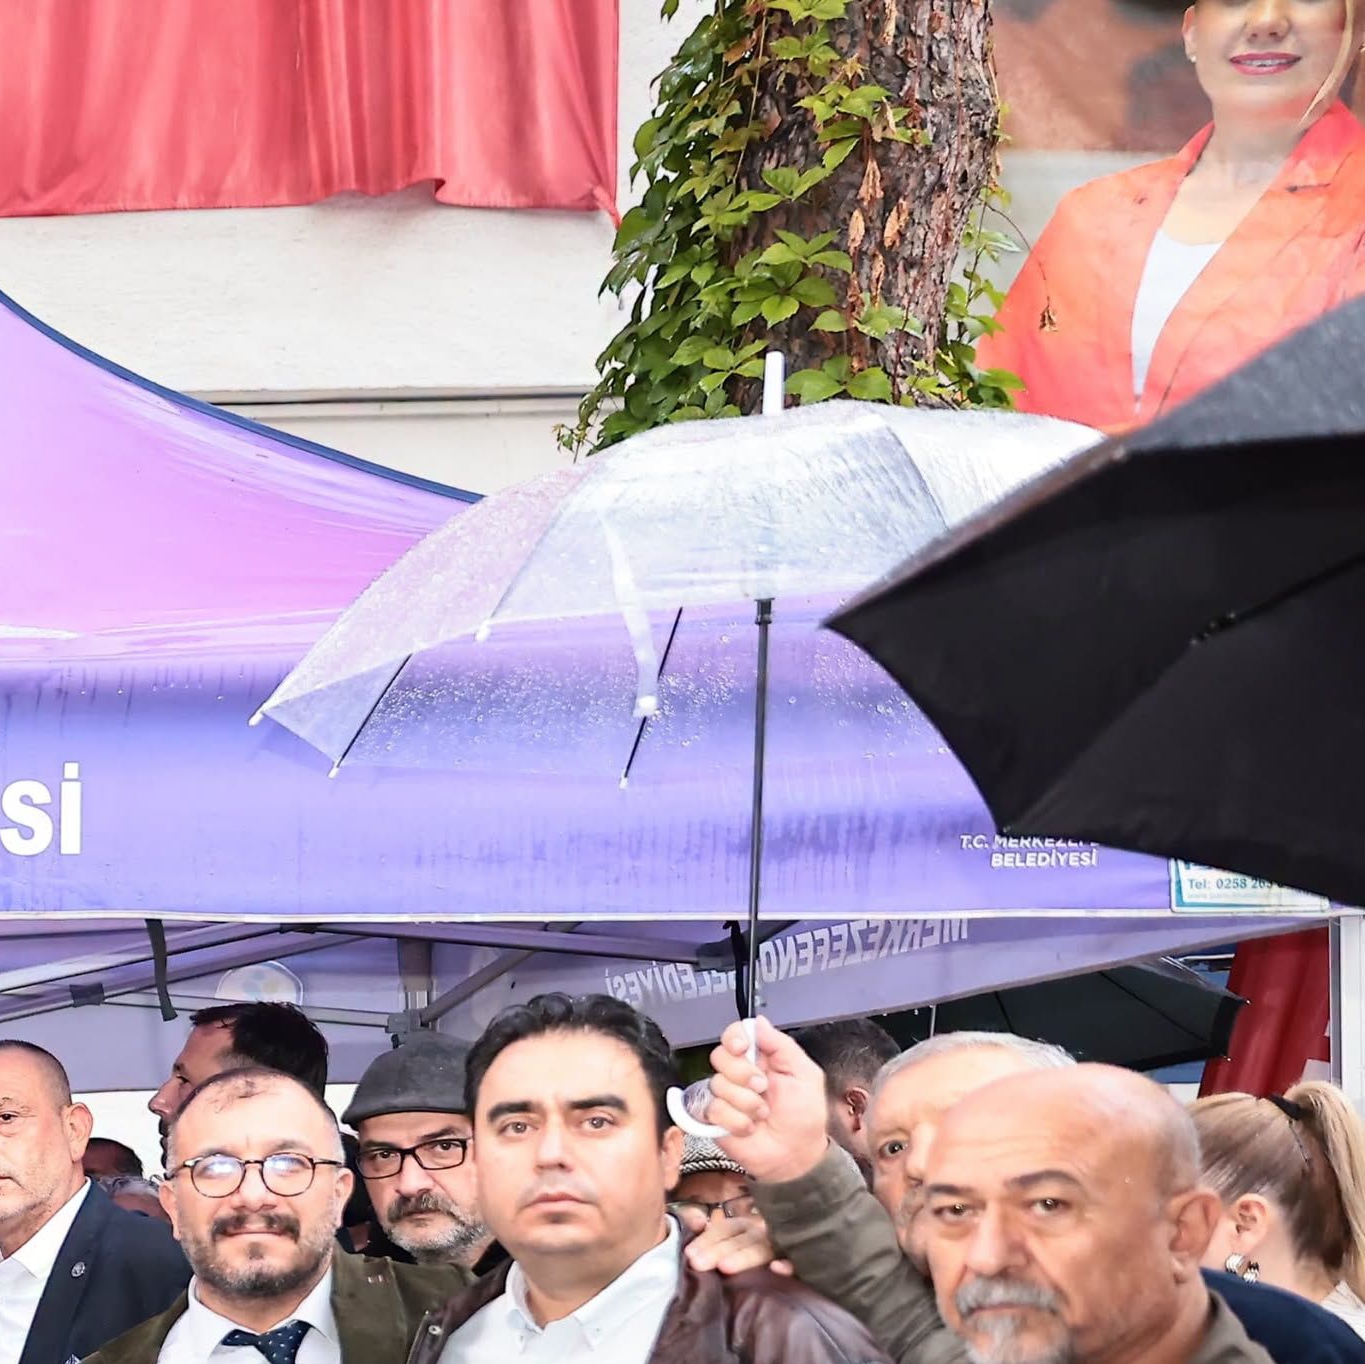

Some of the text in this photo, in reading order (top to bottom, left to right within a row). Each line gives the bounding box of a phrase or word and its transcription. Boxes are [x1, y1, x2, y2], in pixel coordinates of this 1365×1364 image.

[960, 835, 989, 849] T.C.
[991, 849, 1098, 868] BELEDİYESİ
[1188, 878, 1211, 890] Tel:
[1216, 877, 1248, 889] 0258
